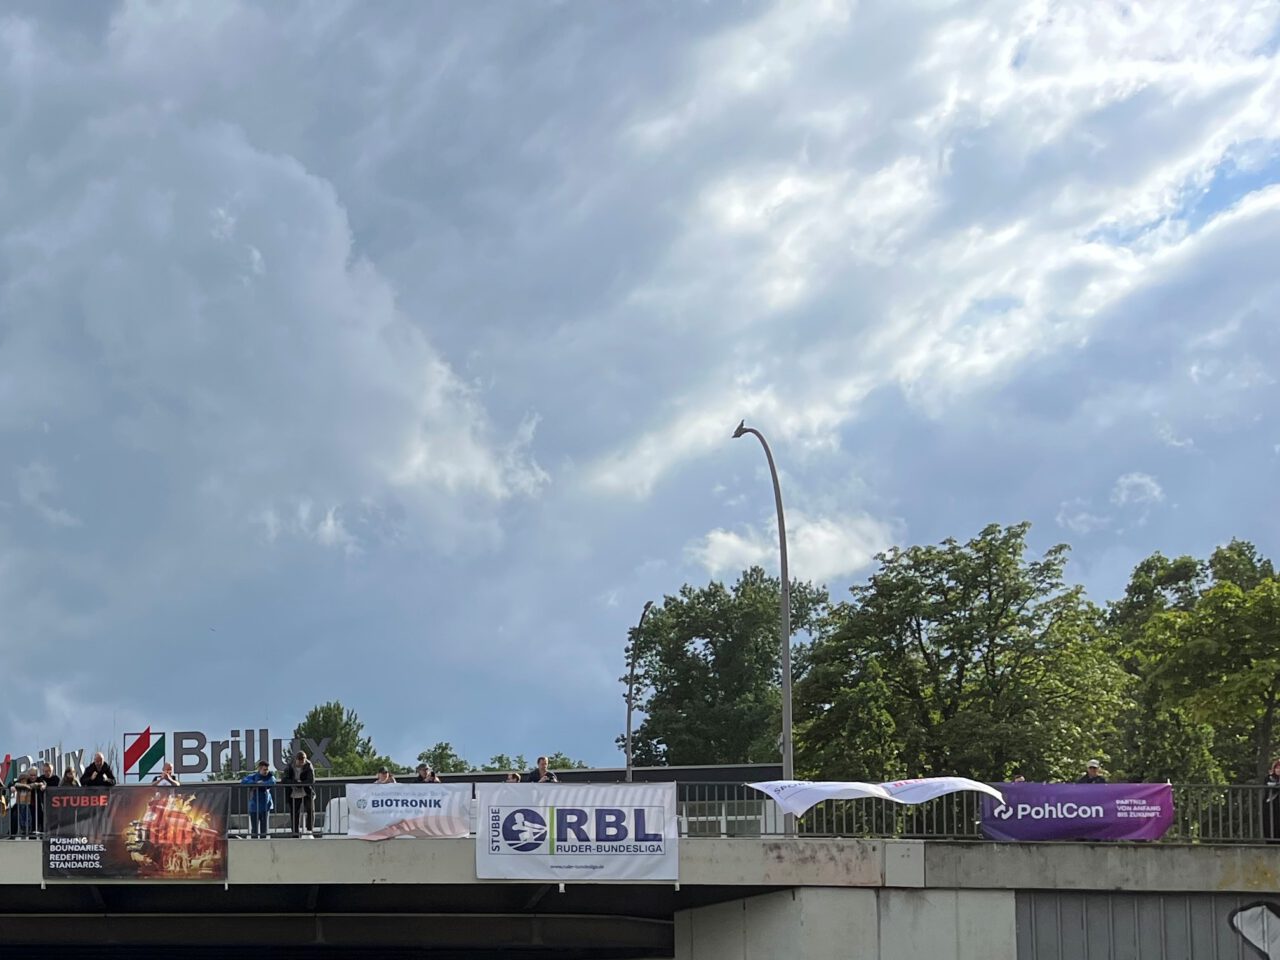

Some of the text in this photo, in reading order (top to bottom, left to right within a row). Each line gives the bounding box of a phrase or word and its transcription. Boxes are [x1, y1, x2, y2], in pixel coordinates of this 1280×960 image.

[173, 729, 333, 774] Brillux
[371, 798, 442, 809] BIOTRONIK
[1017, 802, 1104, 819] PohlCon
[556, 808, 662, 842] RBL
[49, 844, 107, 852] BOUNDARIES.
[556, 844, 662, 853] RUDER-BUNDESLIGA
[49, 853, 100, 861] REDEFINING
